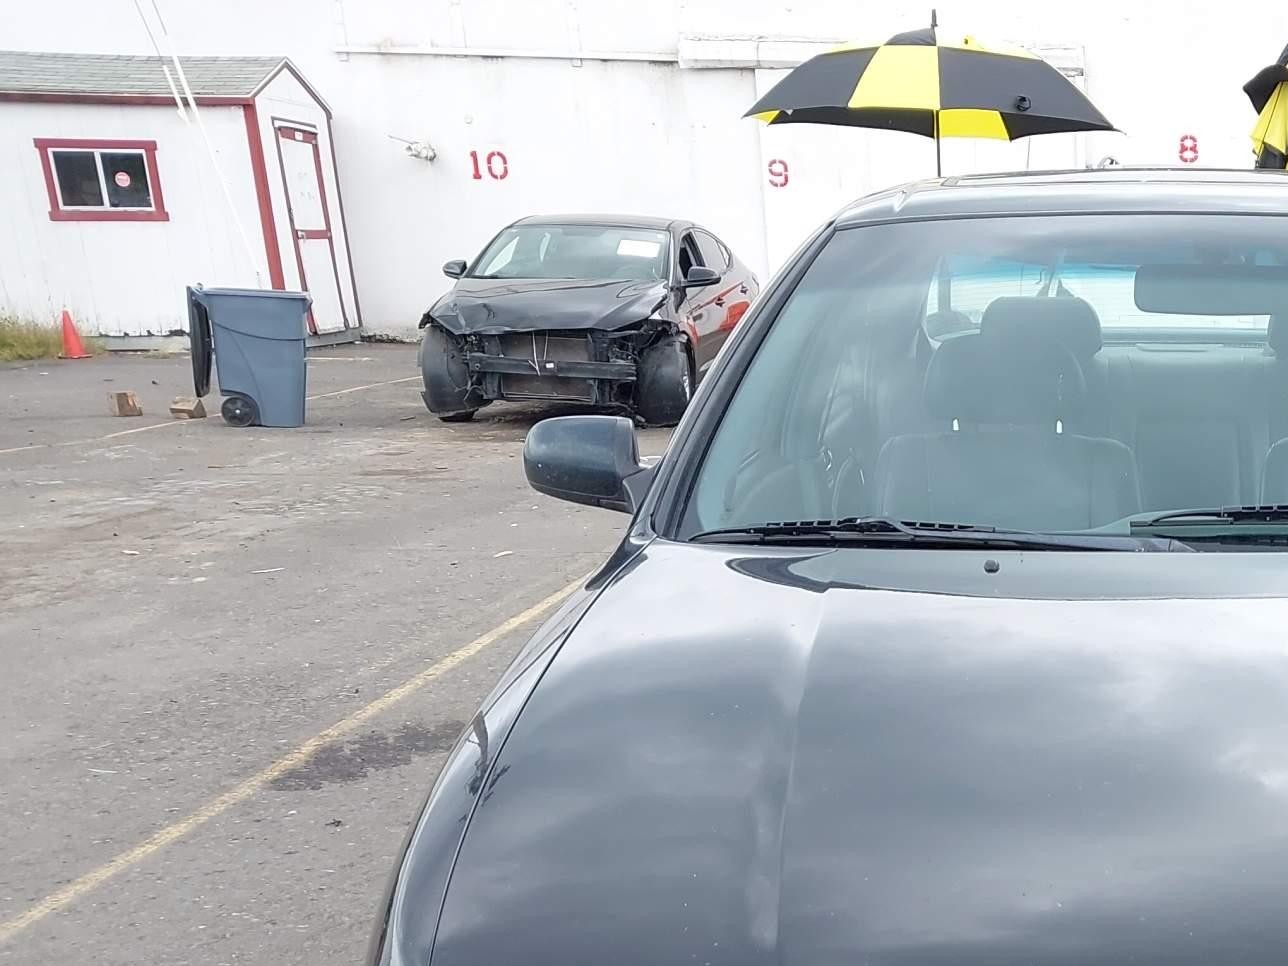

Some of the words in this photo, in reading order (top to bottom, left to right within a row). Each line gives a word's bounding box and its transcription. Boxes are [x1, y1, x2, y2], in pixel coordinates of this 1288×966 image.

[1179, 135, 1198, 163] 8
[470, 151, 508, 180] 10
[768, 159, 789, 187] 9
